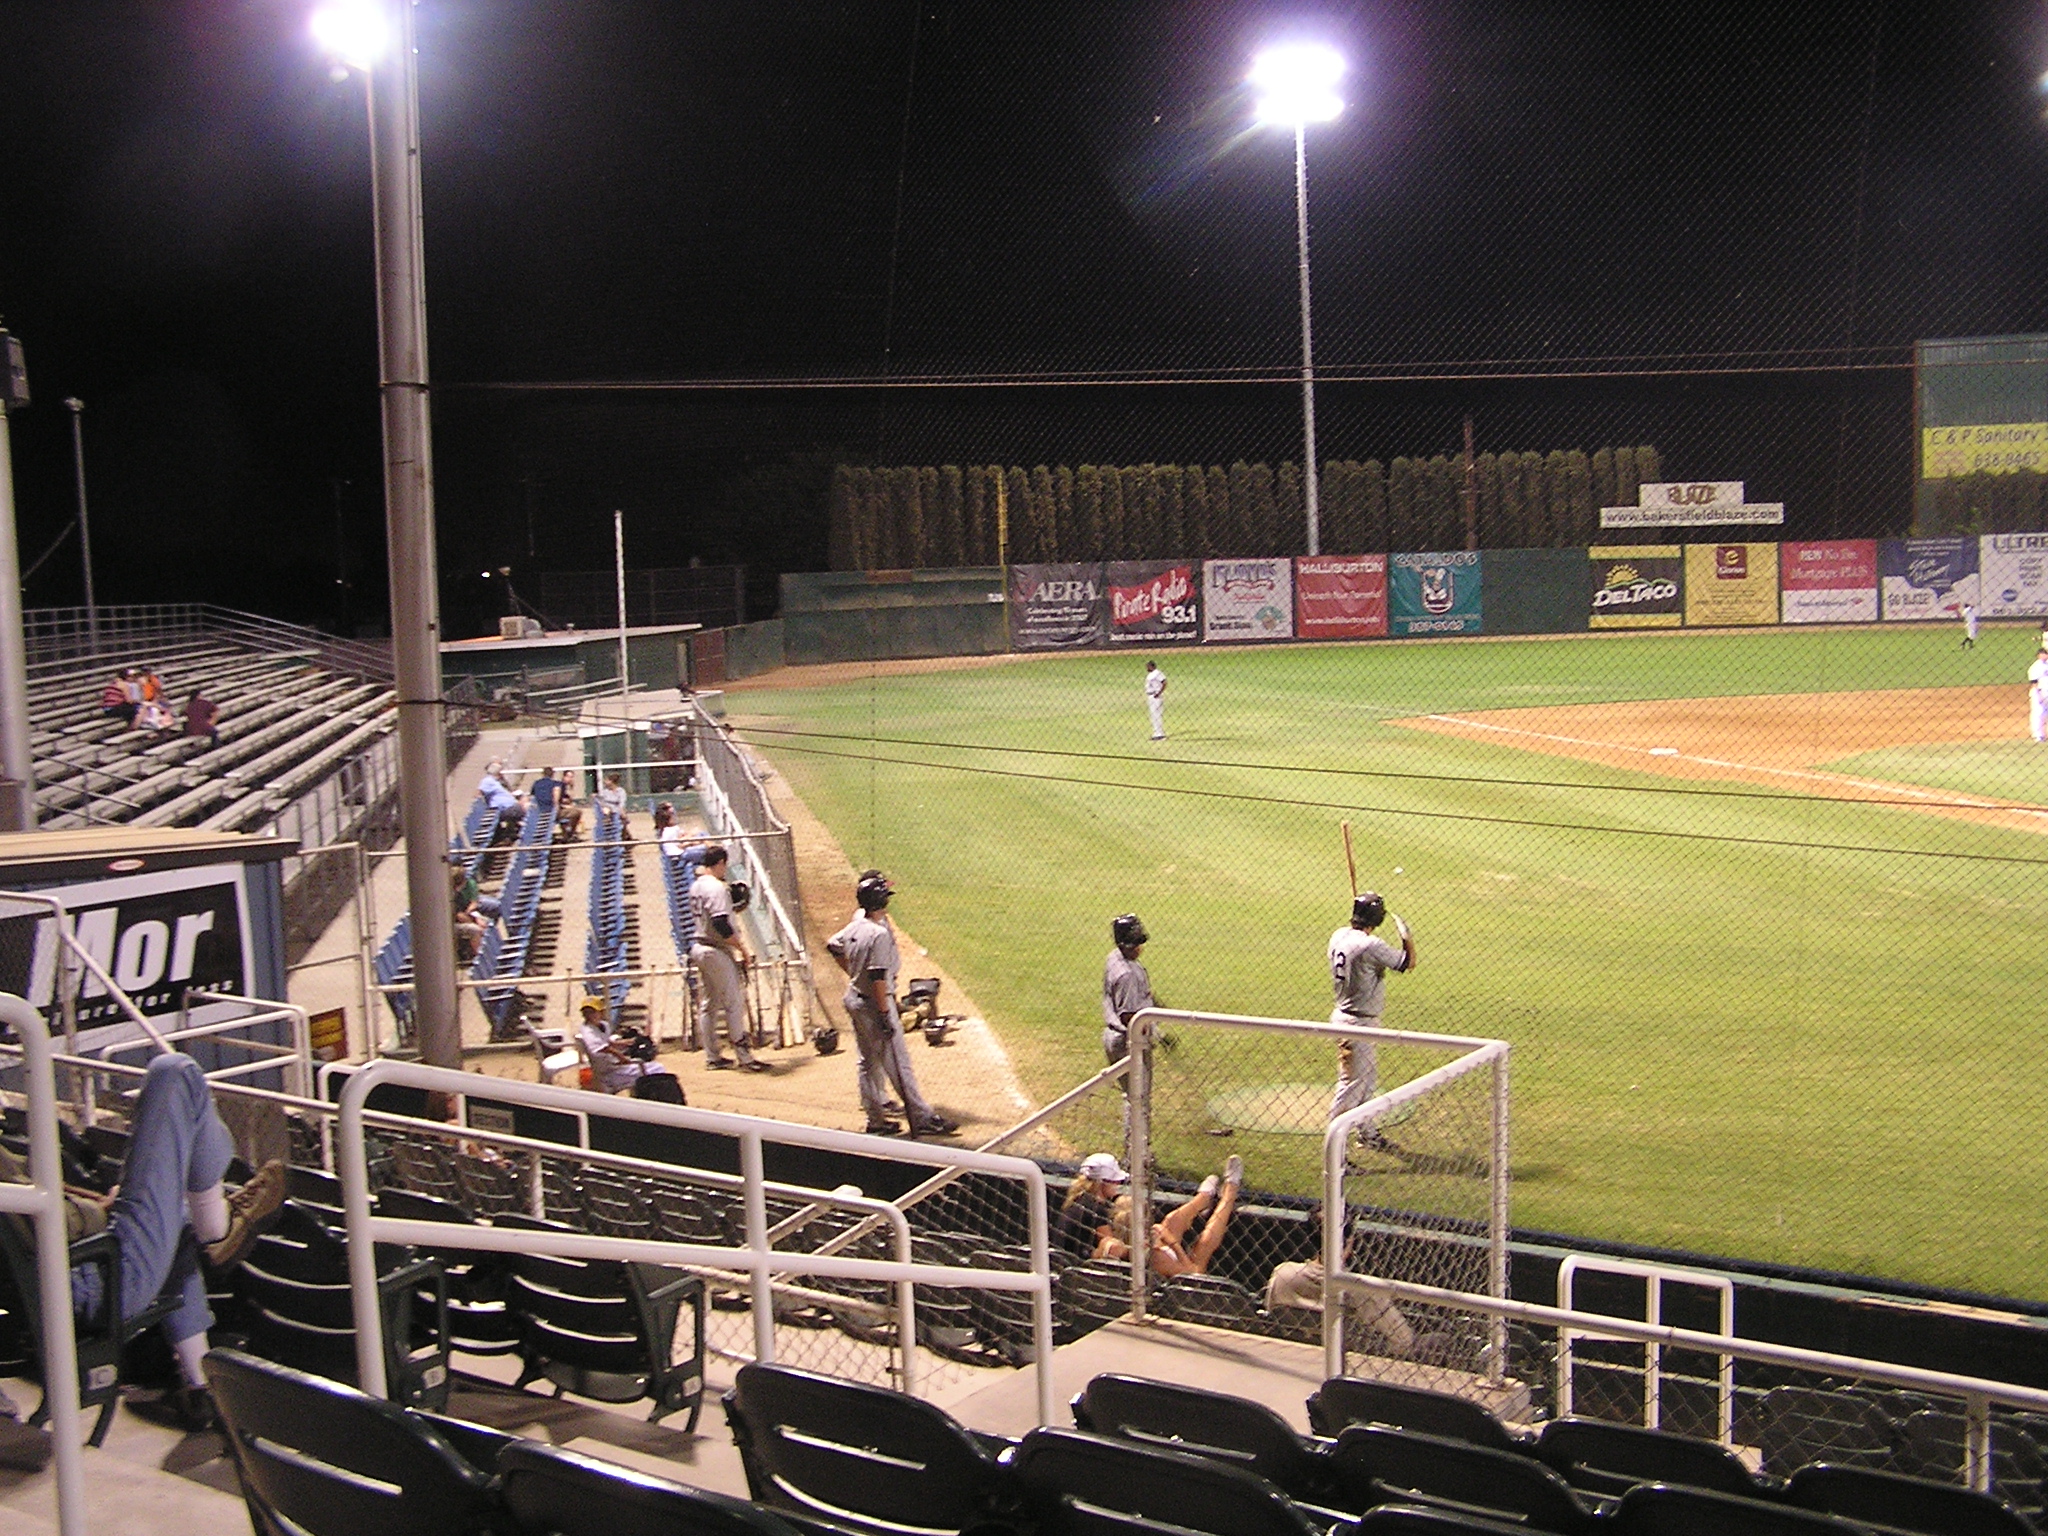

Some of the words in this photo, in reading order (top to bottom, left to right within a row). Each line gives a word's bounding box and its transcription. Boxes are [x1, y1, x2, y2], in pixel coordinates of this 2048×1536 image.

[1976, 427, 2040, 444] Sanitary
[1605, 508, 1779, 522] www.bakersfieldblaze.com
[1299, 562, 1383, 574] HALLIBURTON
[1028, 580, 1101, 602] AERA
[1161, 604, 1197, 624] 93.1
[27, 906, 215, 1007] Mor
